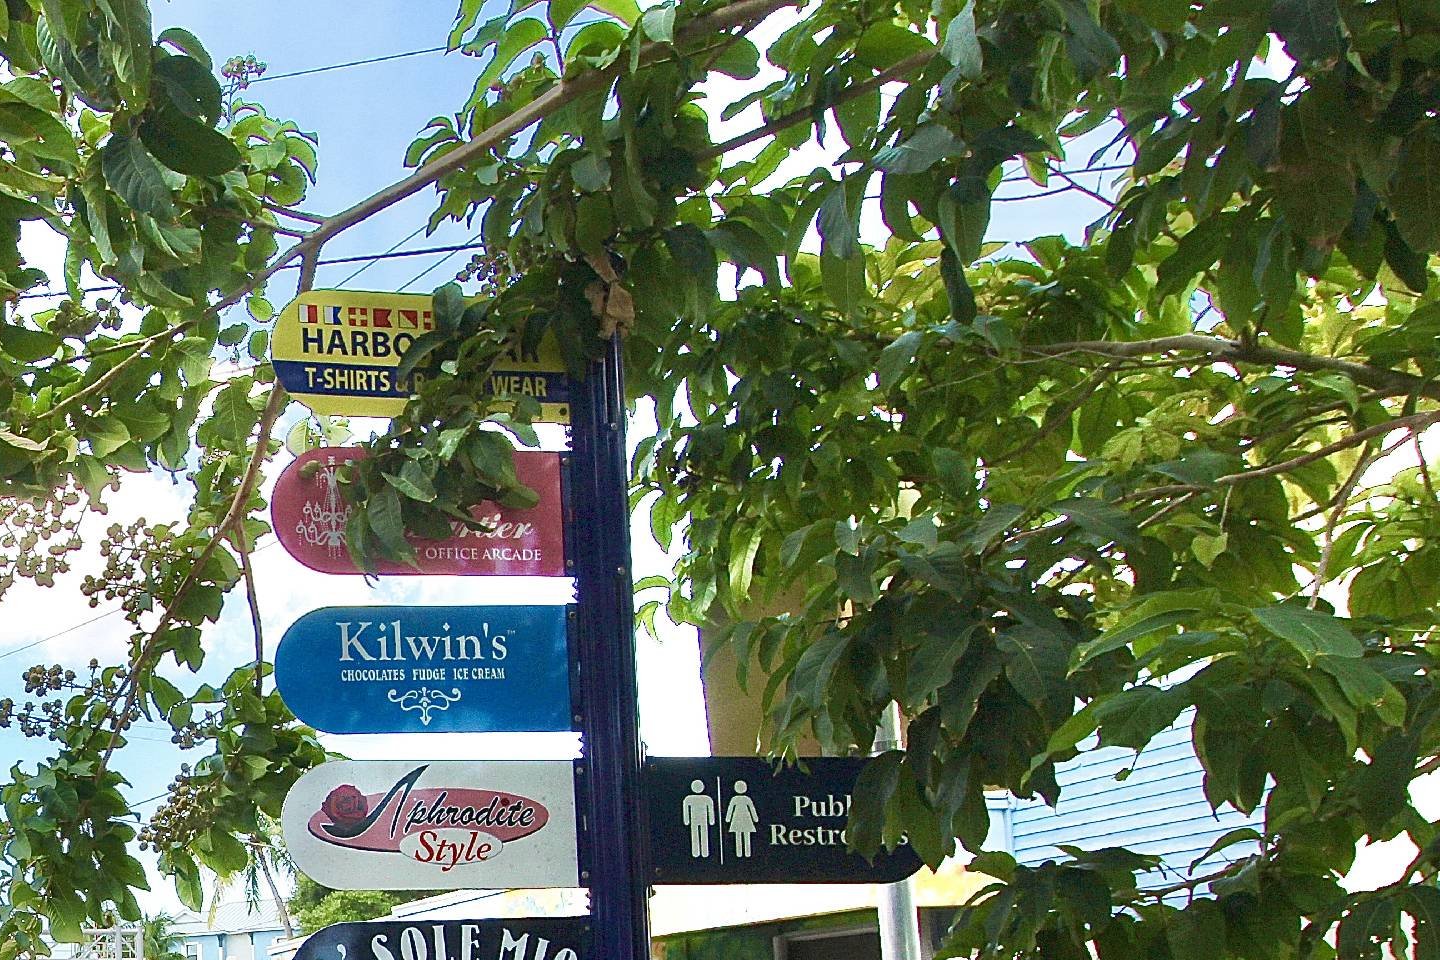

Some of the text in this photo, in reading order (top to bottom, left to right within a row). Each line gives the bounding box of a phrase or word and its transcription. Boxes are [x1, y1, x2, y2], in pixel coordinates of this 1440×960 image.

[302, 327, 415, 358] HARBO
[304, 367, 391, 392] T-SHIRTS
[491, 374, 547, 398] WEAR
[425, 547, 478, 560] OFFICE
[481, 548, 542, 561] ARCADE
[336, 620, 508, 662] Kilwin's
[341, 667, 505, 681] CHOCOLATES FUDGE ICE CREAM
[320, 764, 536, 839] Aphrodite
[792, 794, 852, 817] Publ
[414, 831, 493, 872] Style
